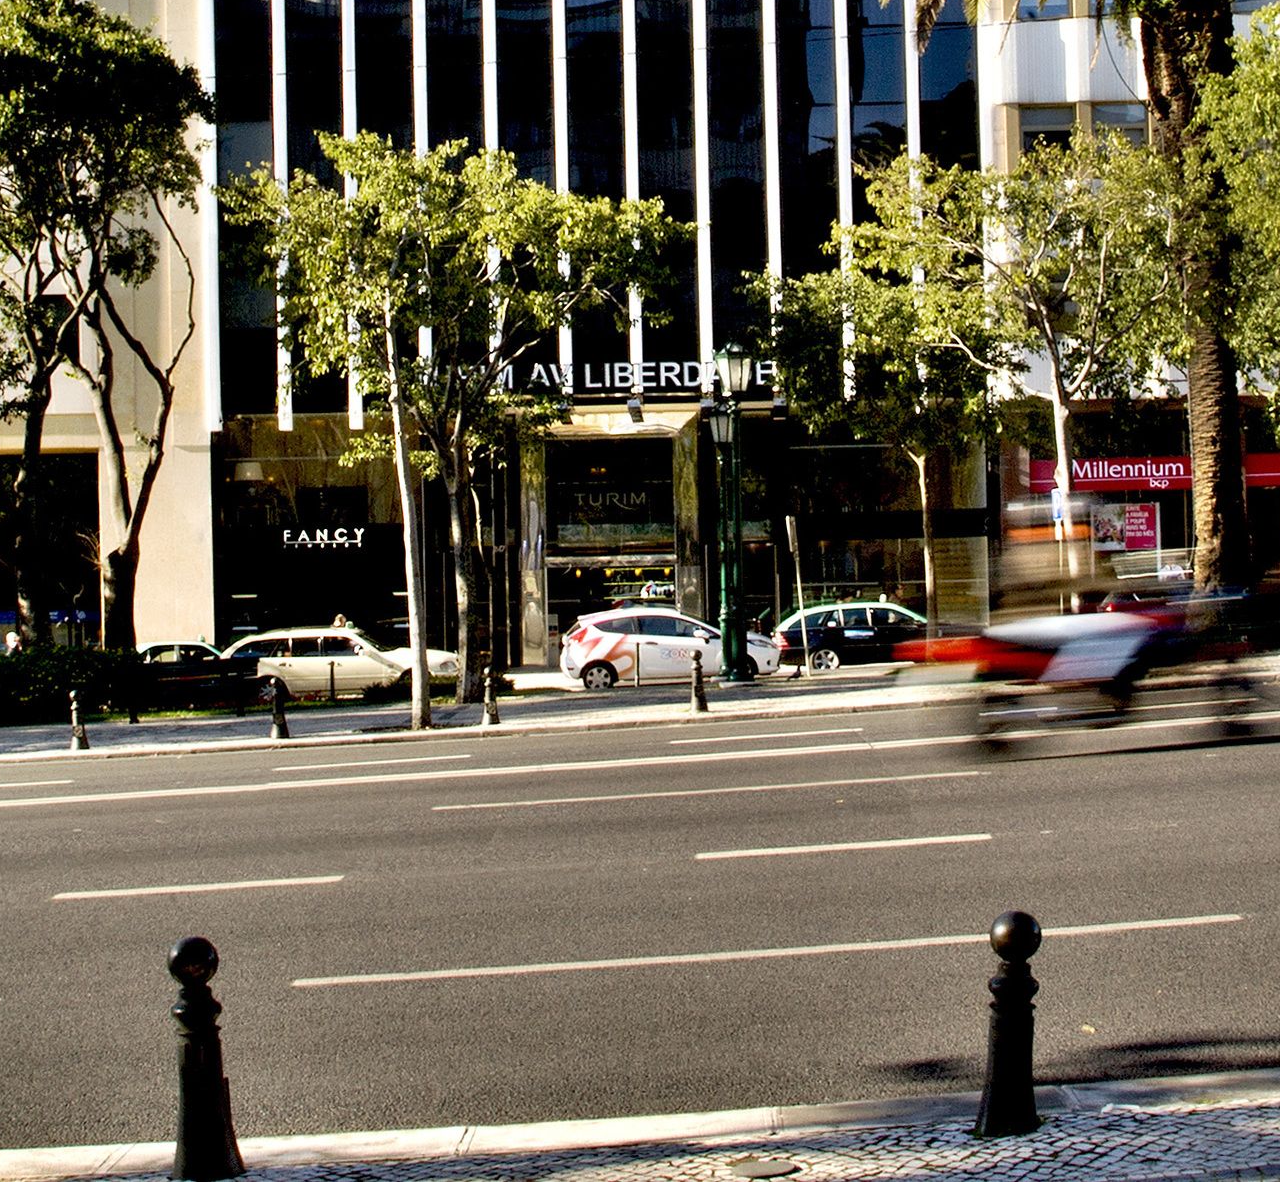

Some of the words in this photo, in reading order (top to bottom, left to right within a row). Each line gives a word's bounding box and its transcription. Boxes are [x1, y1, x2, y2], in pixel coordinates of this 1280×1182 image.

[1072, 459, 1185, 479] Millennium
[1149, 478, 1169, 489] bcp
[574, 492, 647, 510] TURIM
[283, 528, 365, 542] FANCY
